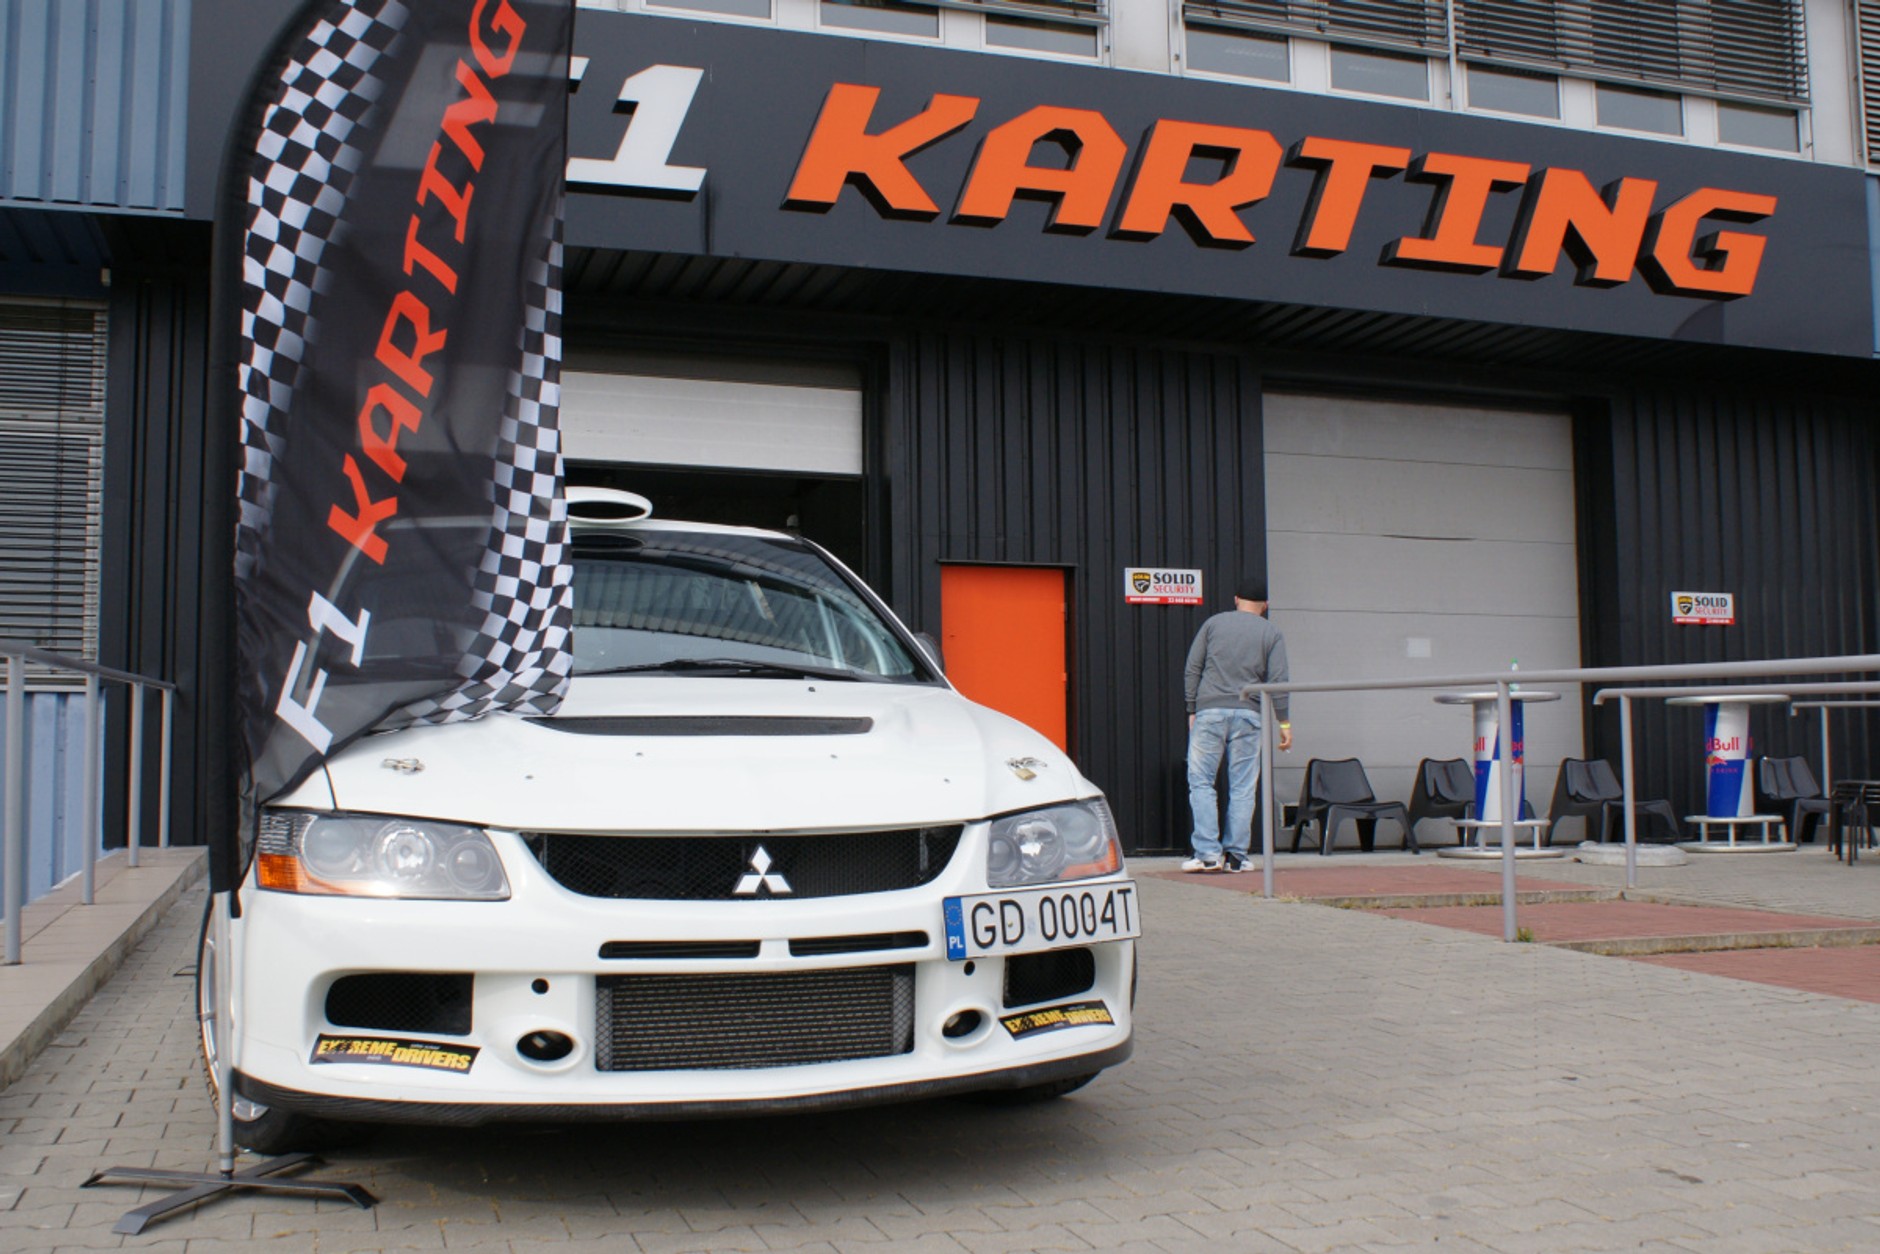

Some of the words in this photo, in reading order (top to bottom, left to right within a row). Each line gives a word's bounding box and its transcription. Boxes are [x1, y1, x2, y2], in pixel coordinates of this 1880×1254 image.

[785, 82, 1778, 298] KARTING
[275, 590, 371, 755] F1
[327, 0, 527, 566] KARTING
[1153, 572, 1195, 584] SOLID
[1153, 585, 1194, 593] SECURITY
[1694, 596, 1727, 607] SOLID
[971, 900, 1024, 949] GD
[1039, 888, 1132, 941] 0004T
[949, 935, 964, 949] PL
[391, 1047, 471, 1069] DRIVERS
